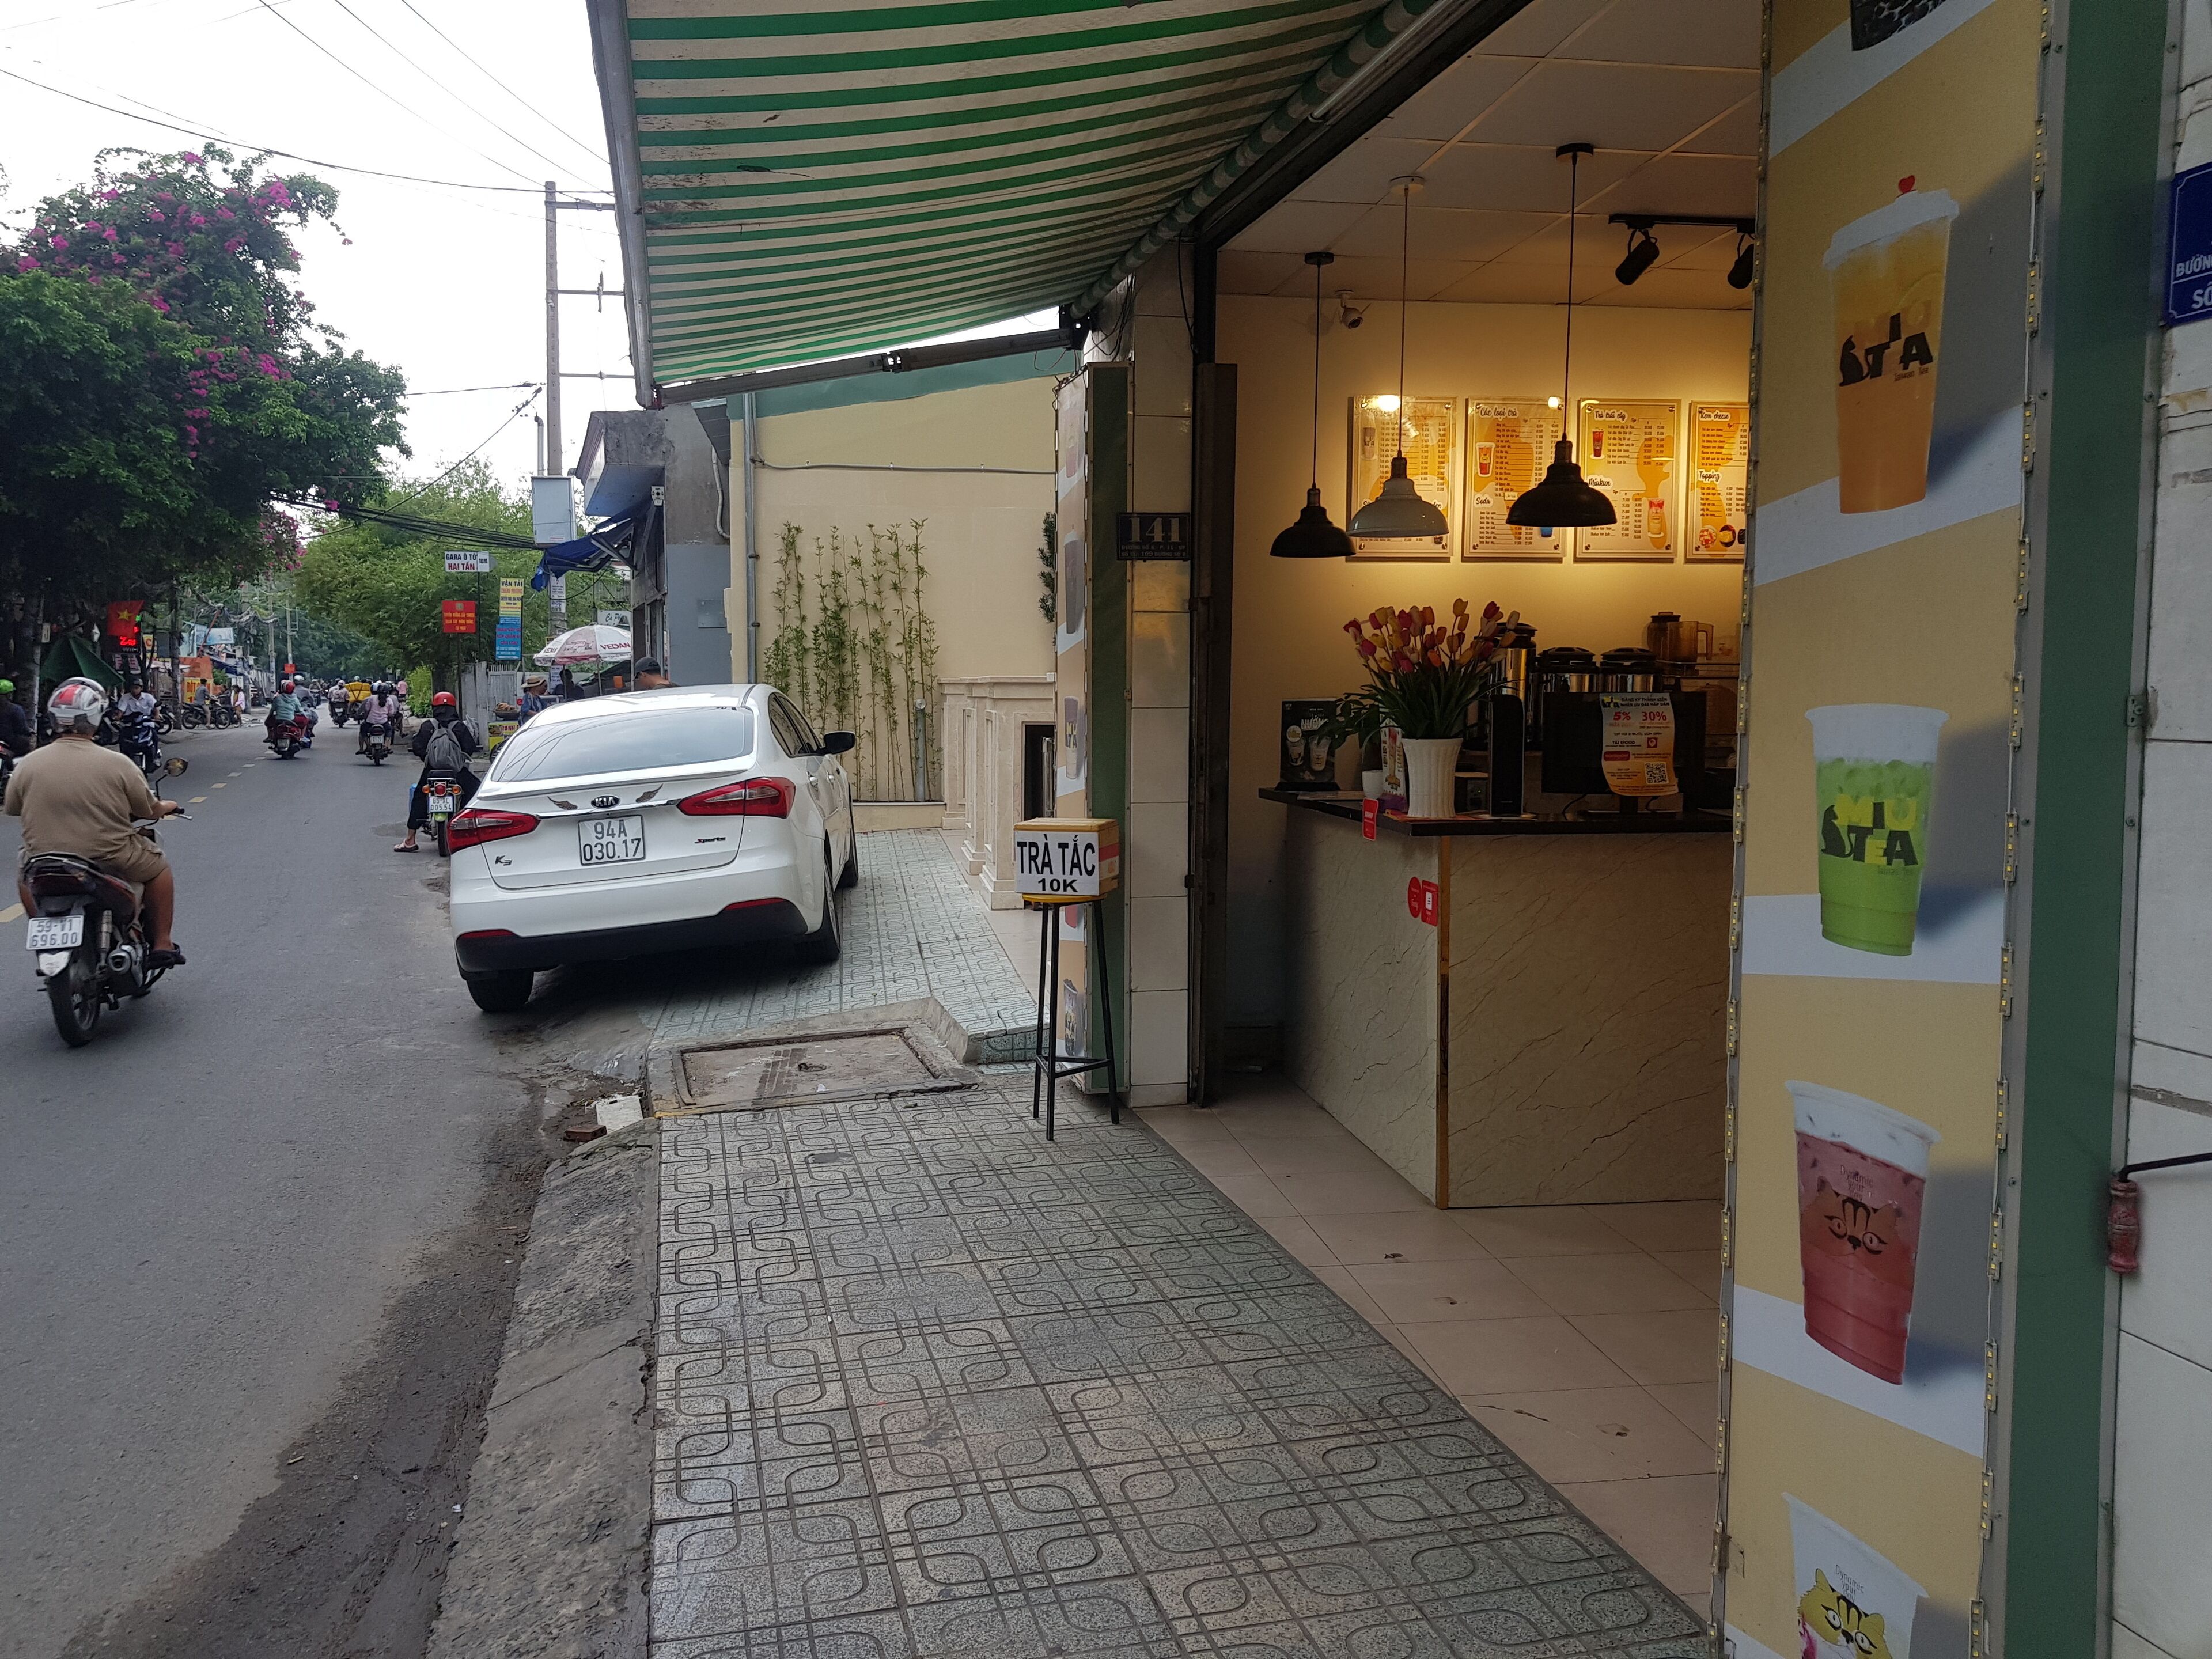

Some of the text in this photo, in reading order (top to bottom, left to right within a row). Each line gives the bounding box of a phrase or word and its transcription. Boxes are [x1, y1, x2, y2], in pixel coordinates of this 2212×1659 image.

[1480, 408, 1492, 416] Các
[1494, 407, 1505, 419] loại
[1699, 471, 1720, 482] Topping
[1476, 497, 1490, 505] Soda
[1128, 517, 1182, 543] 141
[464, 552, 467, 560] Ô
[461, 562, 475, 570] TẤN
[1613, 711, 1666, 721] 5% 30%
[595, 797, 616, 806] KIA
[1834, 793, 1917, 830] MIU
[594, 819, 627, 840] 94A
[583, 838, 641, 862] 030.17
[1847, 825, 1919, 866] TEA
[495, 855, 513, 866] K3
[1017, 834, 1096, 877] TRÀ TẮC
[1038, 878, 1078, 893] 10K
[1840, 1165, 1874, 1188] Dynamic
[1835, 1565, 1864, 1594] Dynamic
[1842, 1580, 1856, 1596] your
